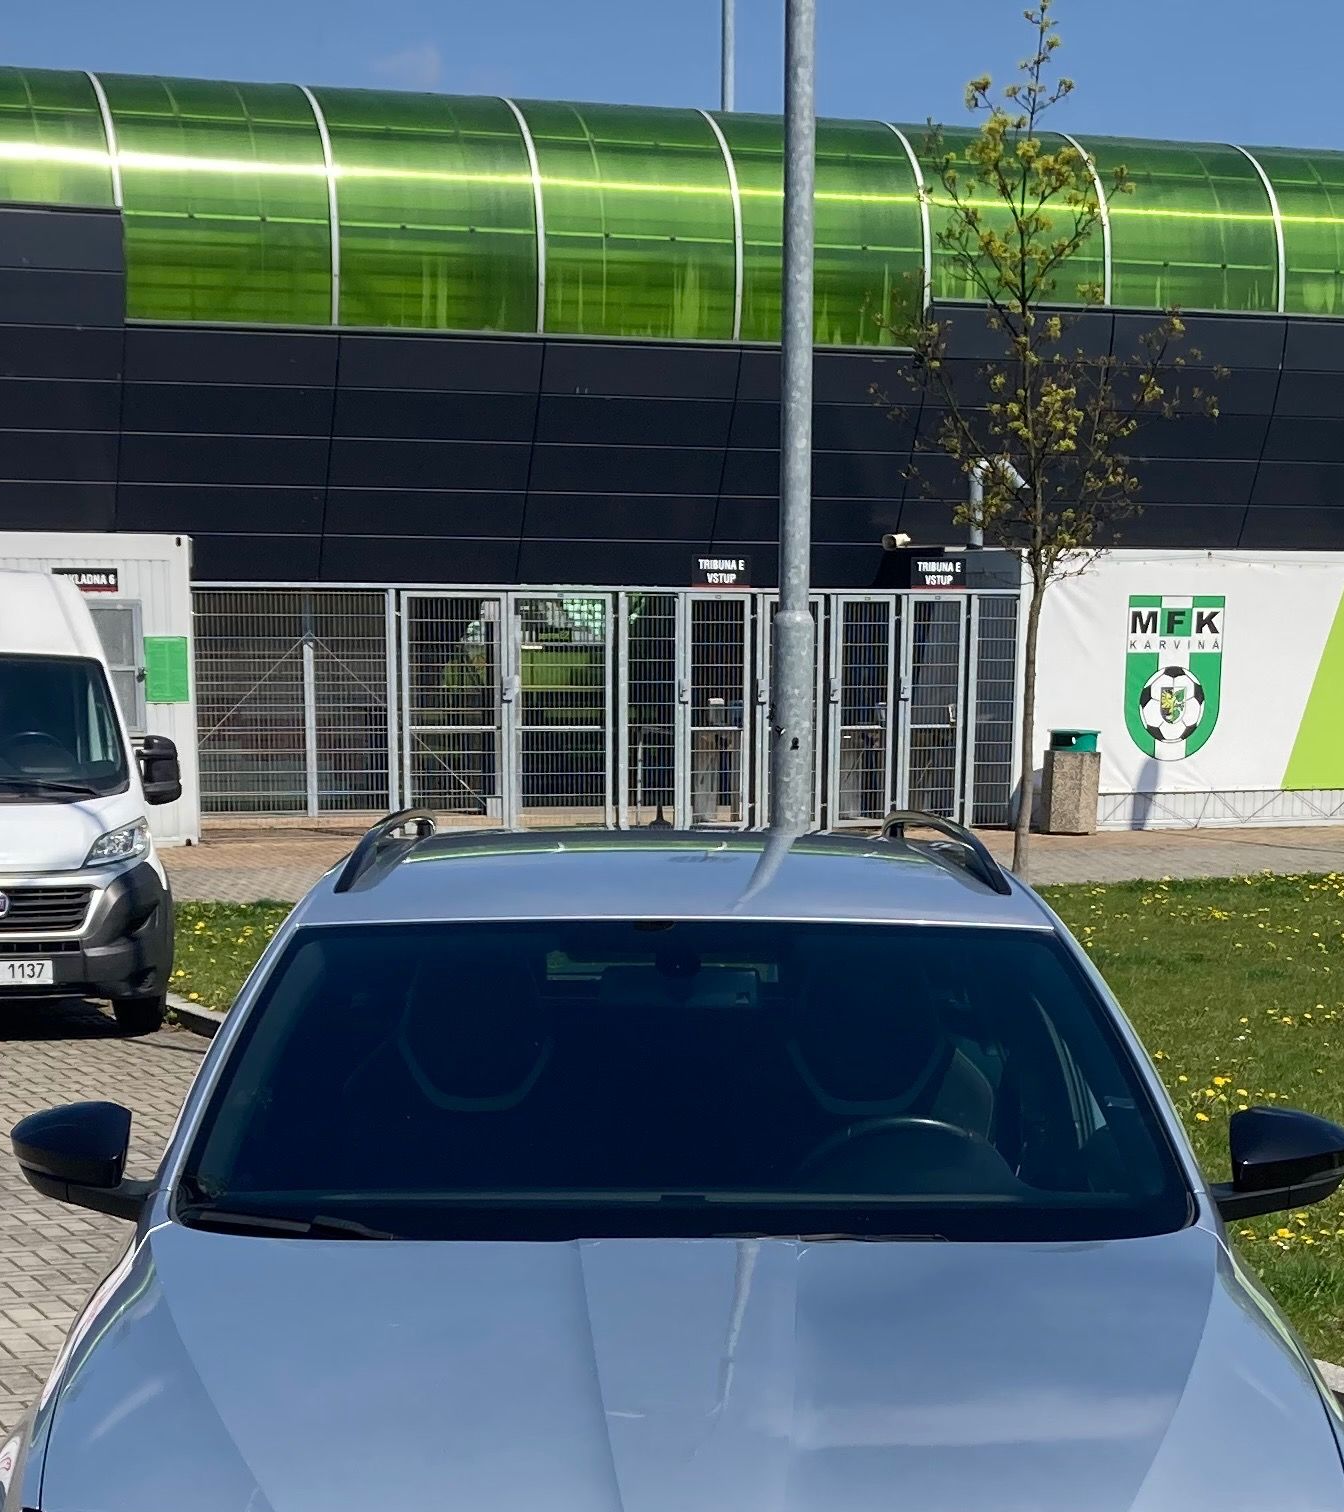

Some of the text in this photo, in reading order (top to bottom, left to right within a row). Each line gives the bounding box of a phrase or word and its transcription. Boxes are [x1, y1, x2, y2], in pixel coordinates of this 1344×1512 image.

[698, 559, 745, 570] TRIBUNA E
[916, 561, 962, 572] TRIBUNA E
[108, 574, 116, 584] 6
[706, 572, 736, 583] VSTUP
[925, 574, 954, 585] VSTUP
[1130, 610, 1221, 635] MFK
[7, 962, 45, 979] 1137
